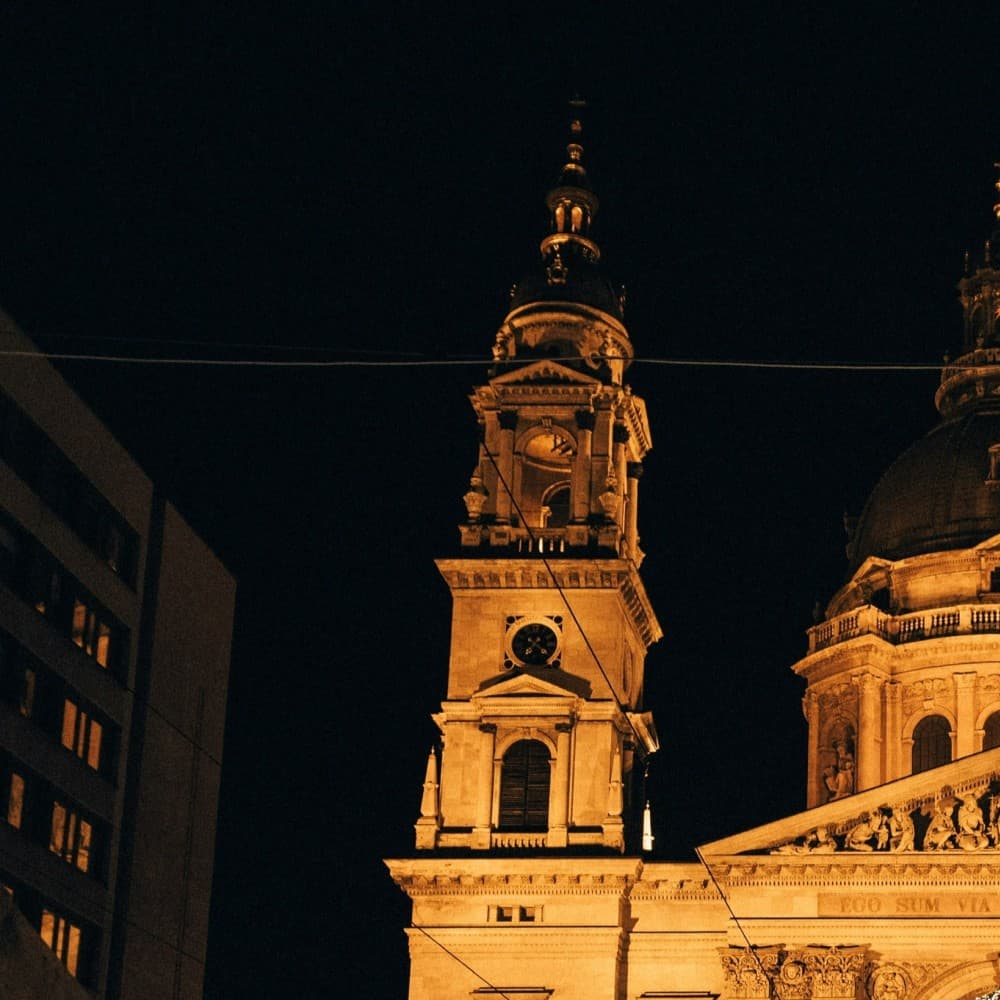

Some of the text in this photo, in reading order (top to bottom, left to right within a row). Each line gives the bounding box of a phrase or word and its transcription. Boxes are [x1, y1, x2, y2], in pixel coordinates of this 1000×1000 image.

[839, 896, 881, 914] EGO
[895, 896, 940, 914] SUM
[957, 896, 991, 914] VIA
